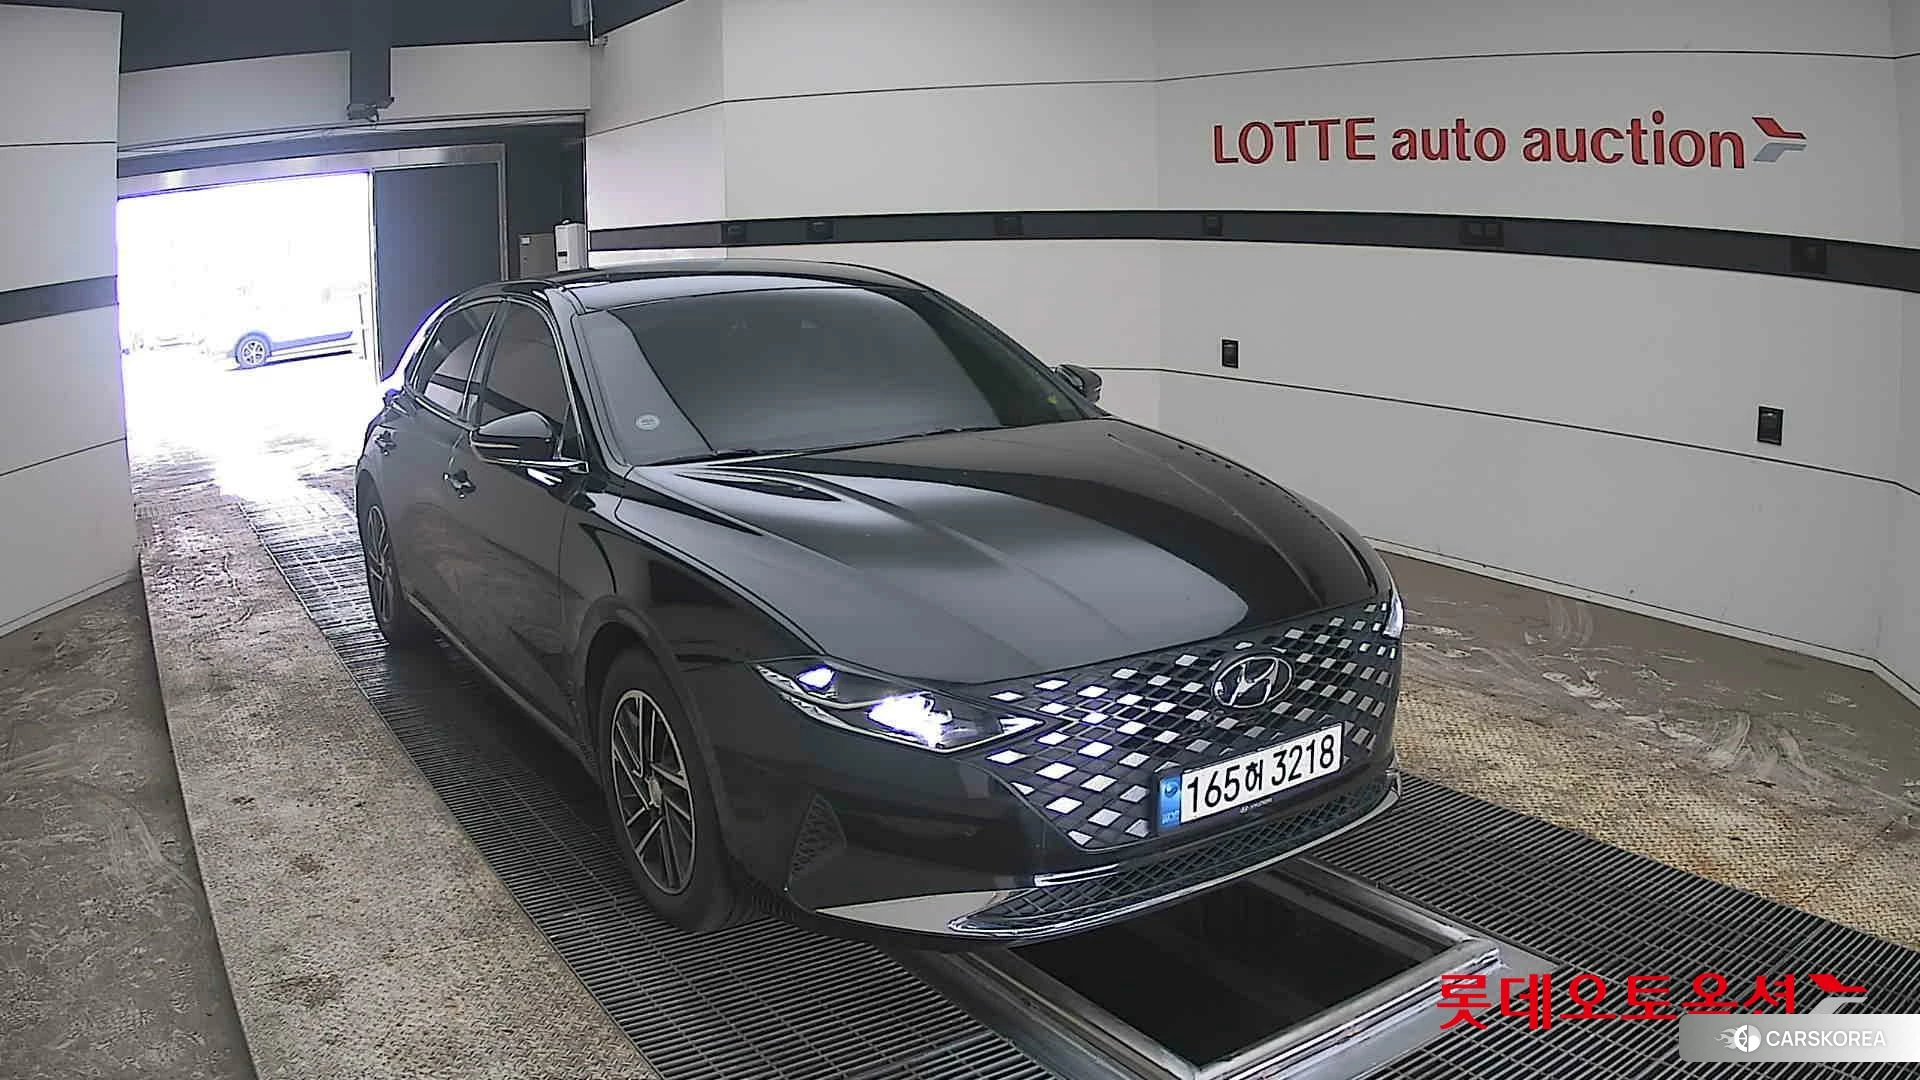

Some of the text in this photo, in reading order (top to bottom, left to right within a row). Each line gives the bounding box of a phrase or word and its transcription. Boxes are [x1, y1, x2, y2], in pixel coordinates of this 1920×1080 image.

[1213, 110, 1744, 169] LOTTE auto auction
[1186, 734, 1335, 813] 165허 3218
